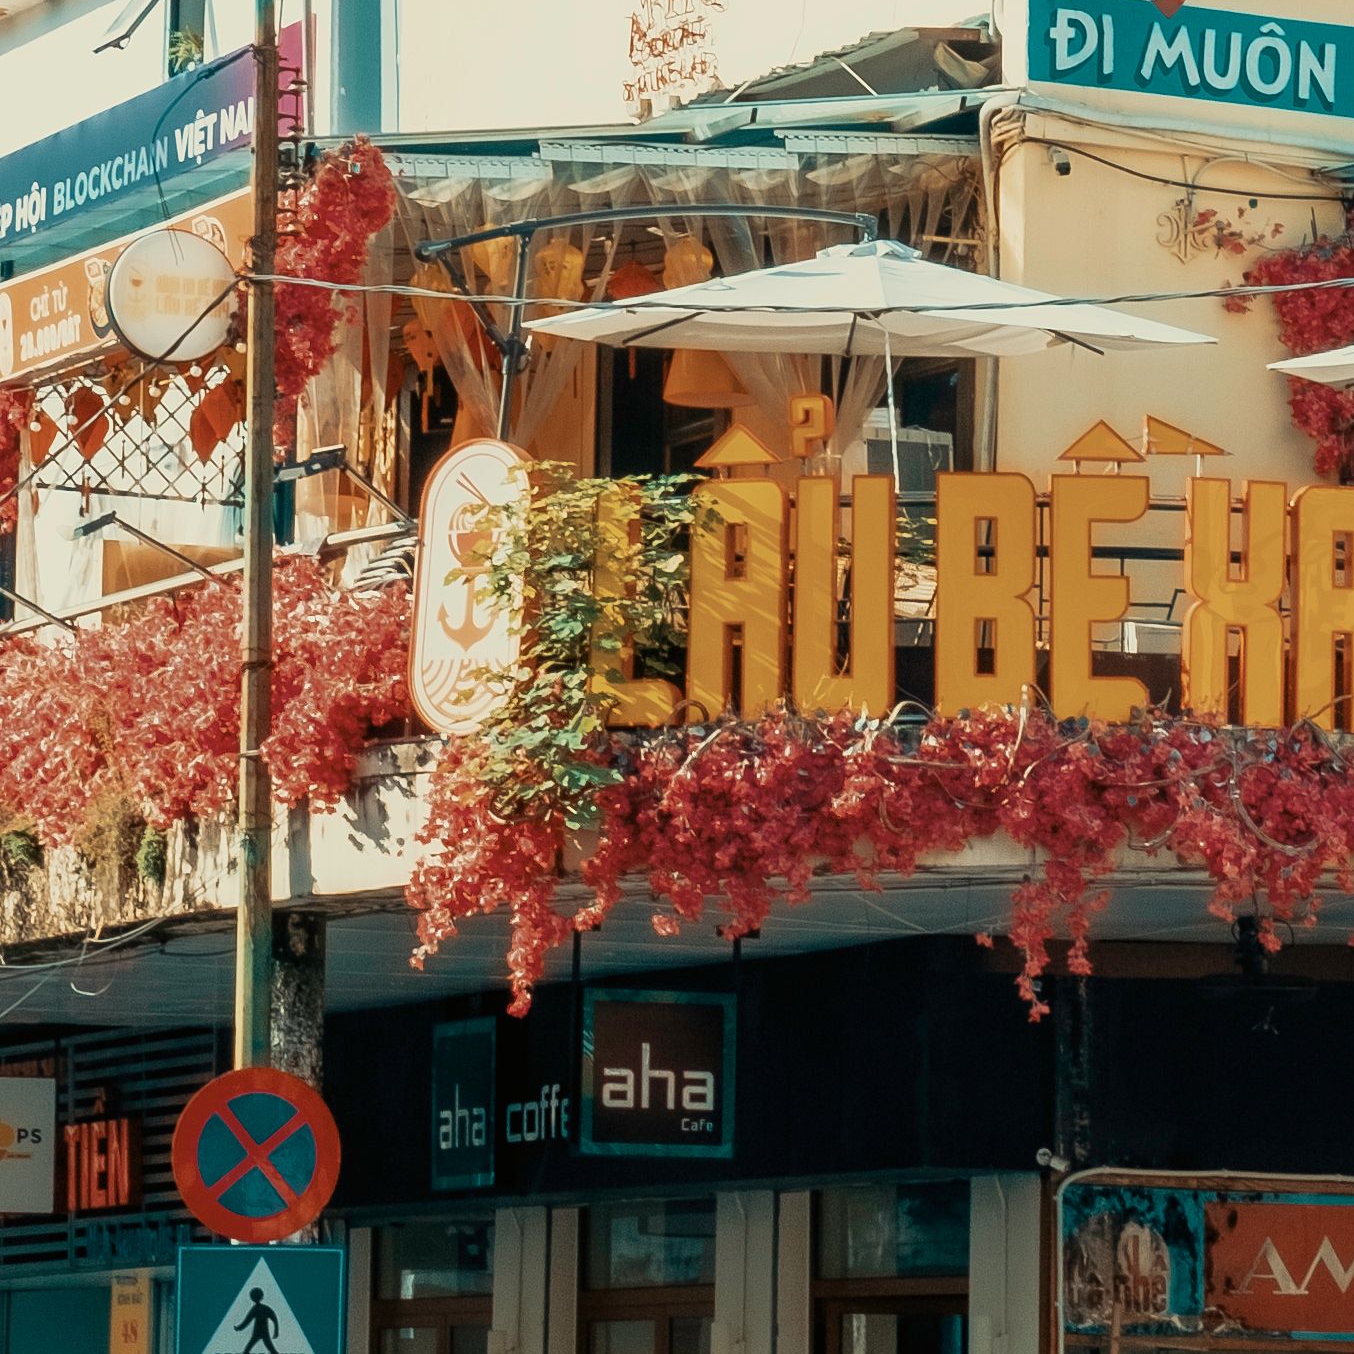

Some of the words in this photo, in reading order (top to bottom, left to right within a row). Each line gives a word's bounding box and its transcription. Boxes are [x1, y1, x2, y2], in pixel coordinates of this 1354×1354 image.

[1048, 7, 1115, 76] ĐI
[1140, 22, 1338, 110] MUÔN
[15, 181, 48, 234] HỘI
[52, 136, 169, 216] BLOCKCHAIN
[174, 108, 219, 166] VIỆT
[602, 1042, 715, 1111] aha
[439, 1083, 487, 1150] aha
[681, 1118, 714, 1132] Cafe
